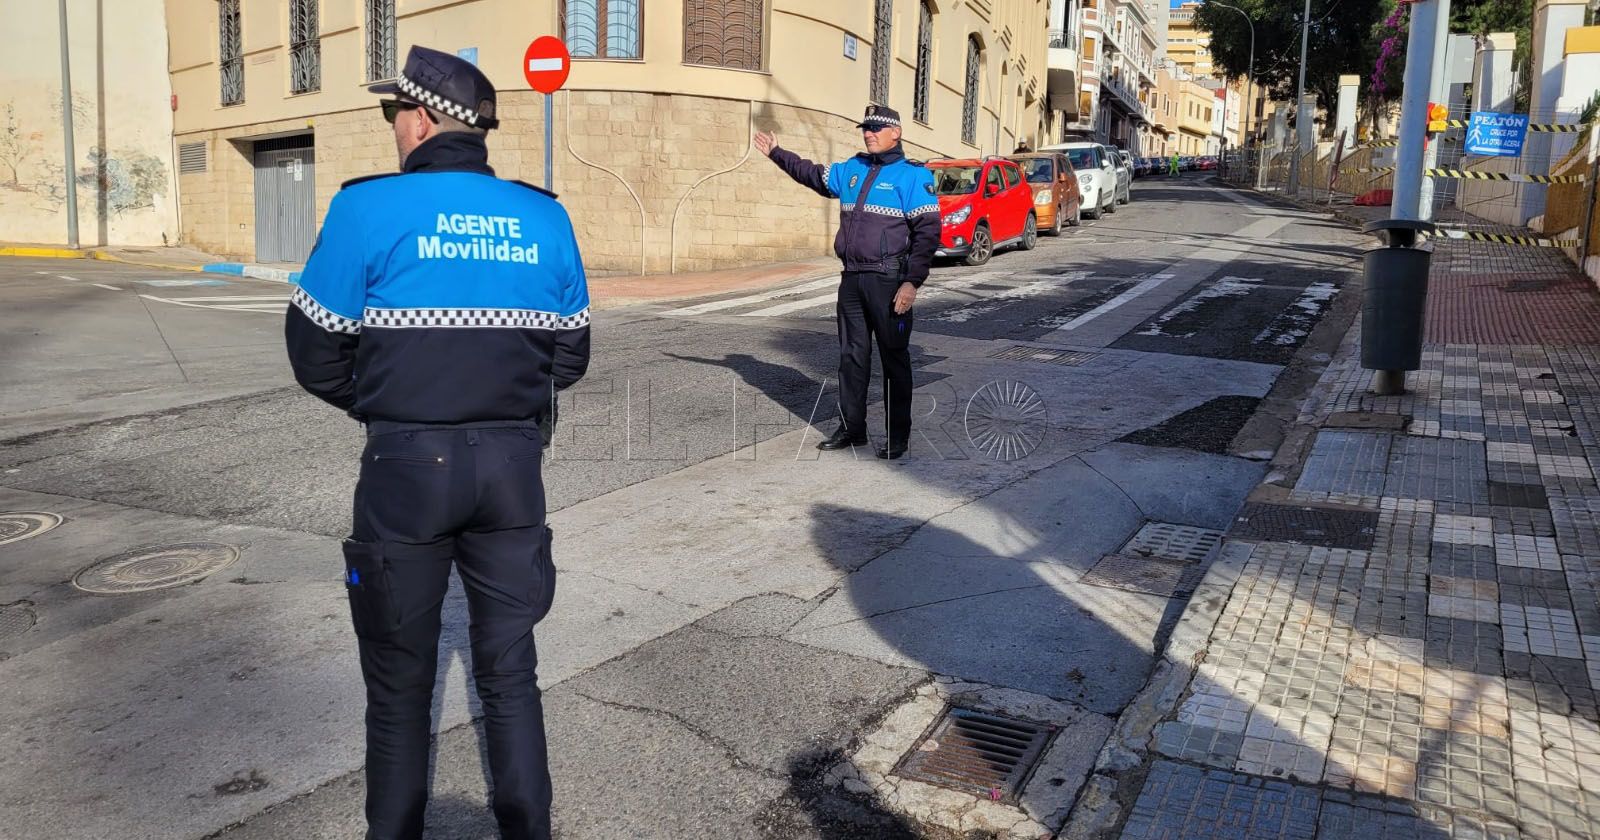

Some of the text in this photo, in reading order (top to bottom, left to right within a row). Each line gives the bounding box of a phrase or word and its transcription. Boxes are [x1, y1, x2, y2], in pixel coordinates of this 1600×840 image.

[1474, 115, 1525, 127] PEATÓN
[436, 213, 522, 238] AGENTE
[417, 235, 539, 265] Movilidad
